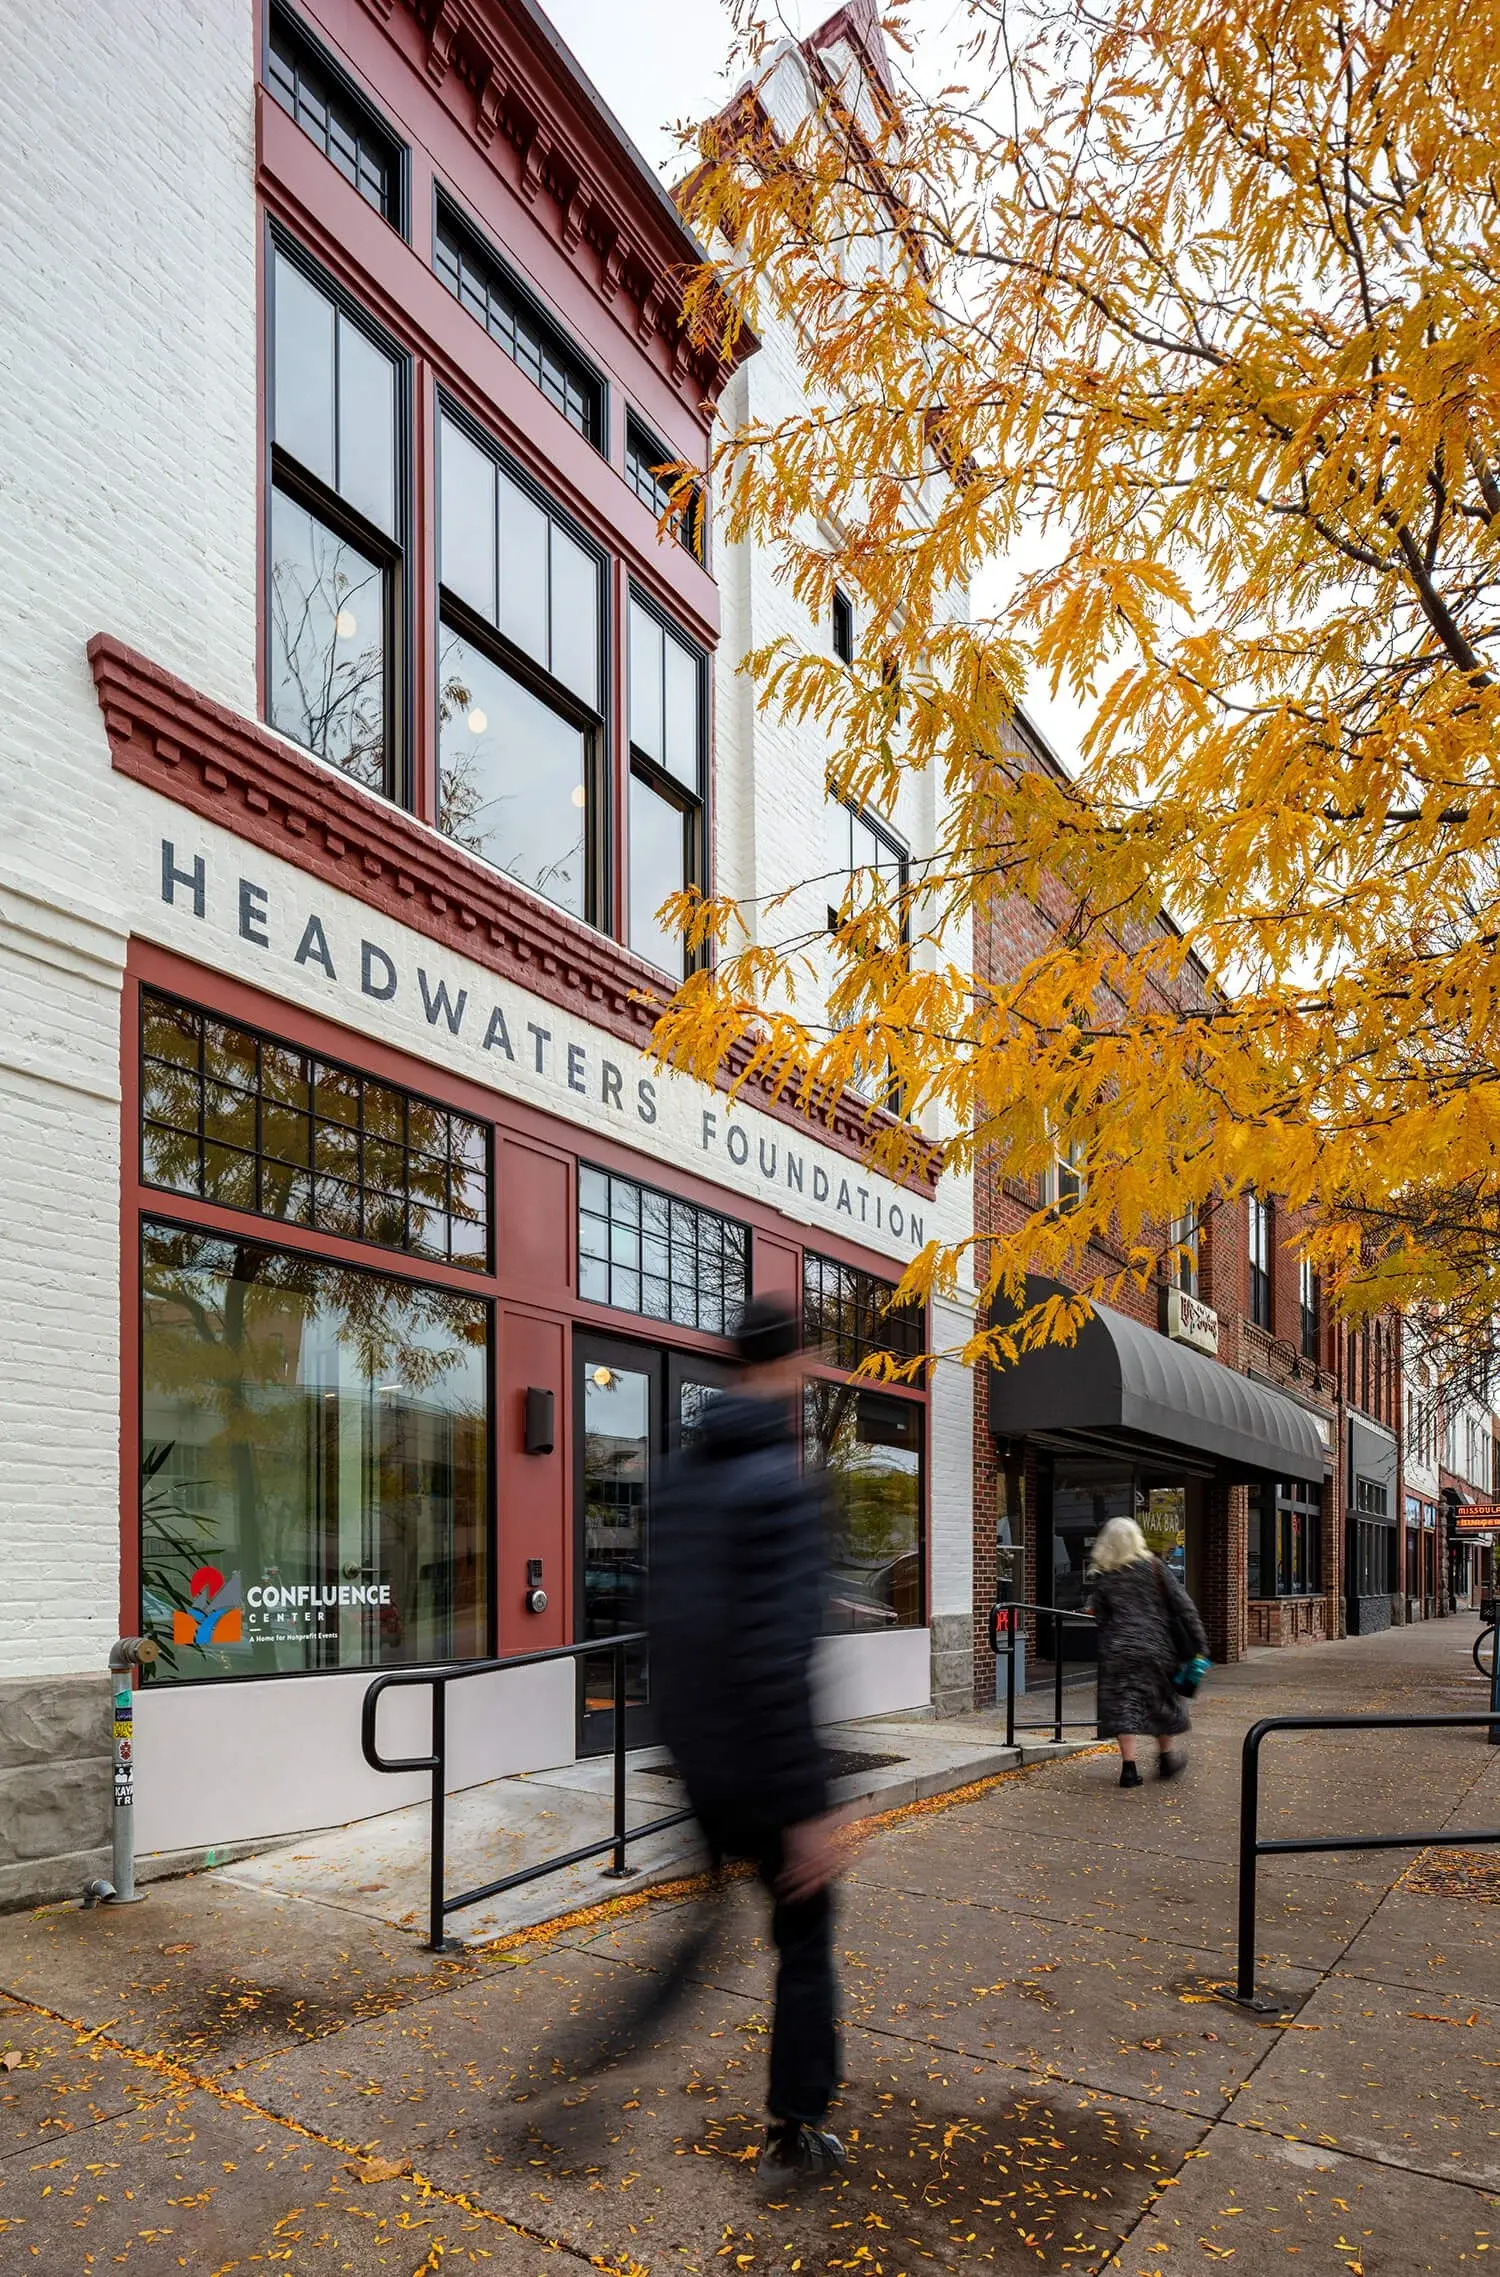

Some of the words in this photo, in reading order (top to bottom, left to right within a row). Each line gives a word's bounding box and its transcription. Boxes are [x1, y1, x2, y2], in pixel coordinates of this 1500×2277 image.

[162, 838, 658, 1125] HEADWATERS
[702, 1109, 925, 1248] FOUNDATION
[1142, 1510, 1162, 1532] WAX
[1163, 1513, 1180, 1533] BAR
[247, 1585, 391, 1608] CONFLUENCE
[248, 1611, 326, 1624] CENTER
[249, 1635, 255, 1643] A
[256, 1634, 275, 1643] Home
[276, 1633, 286, 1641] for
[287, 1632, 317, 1642] Nonprofit
[318, 1631, 338, 1640] Events
